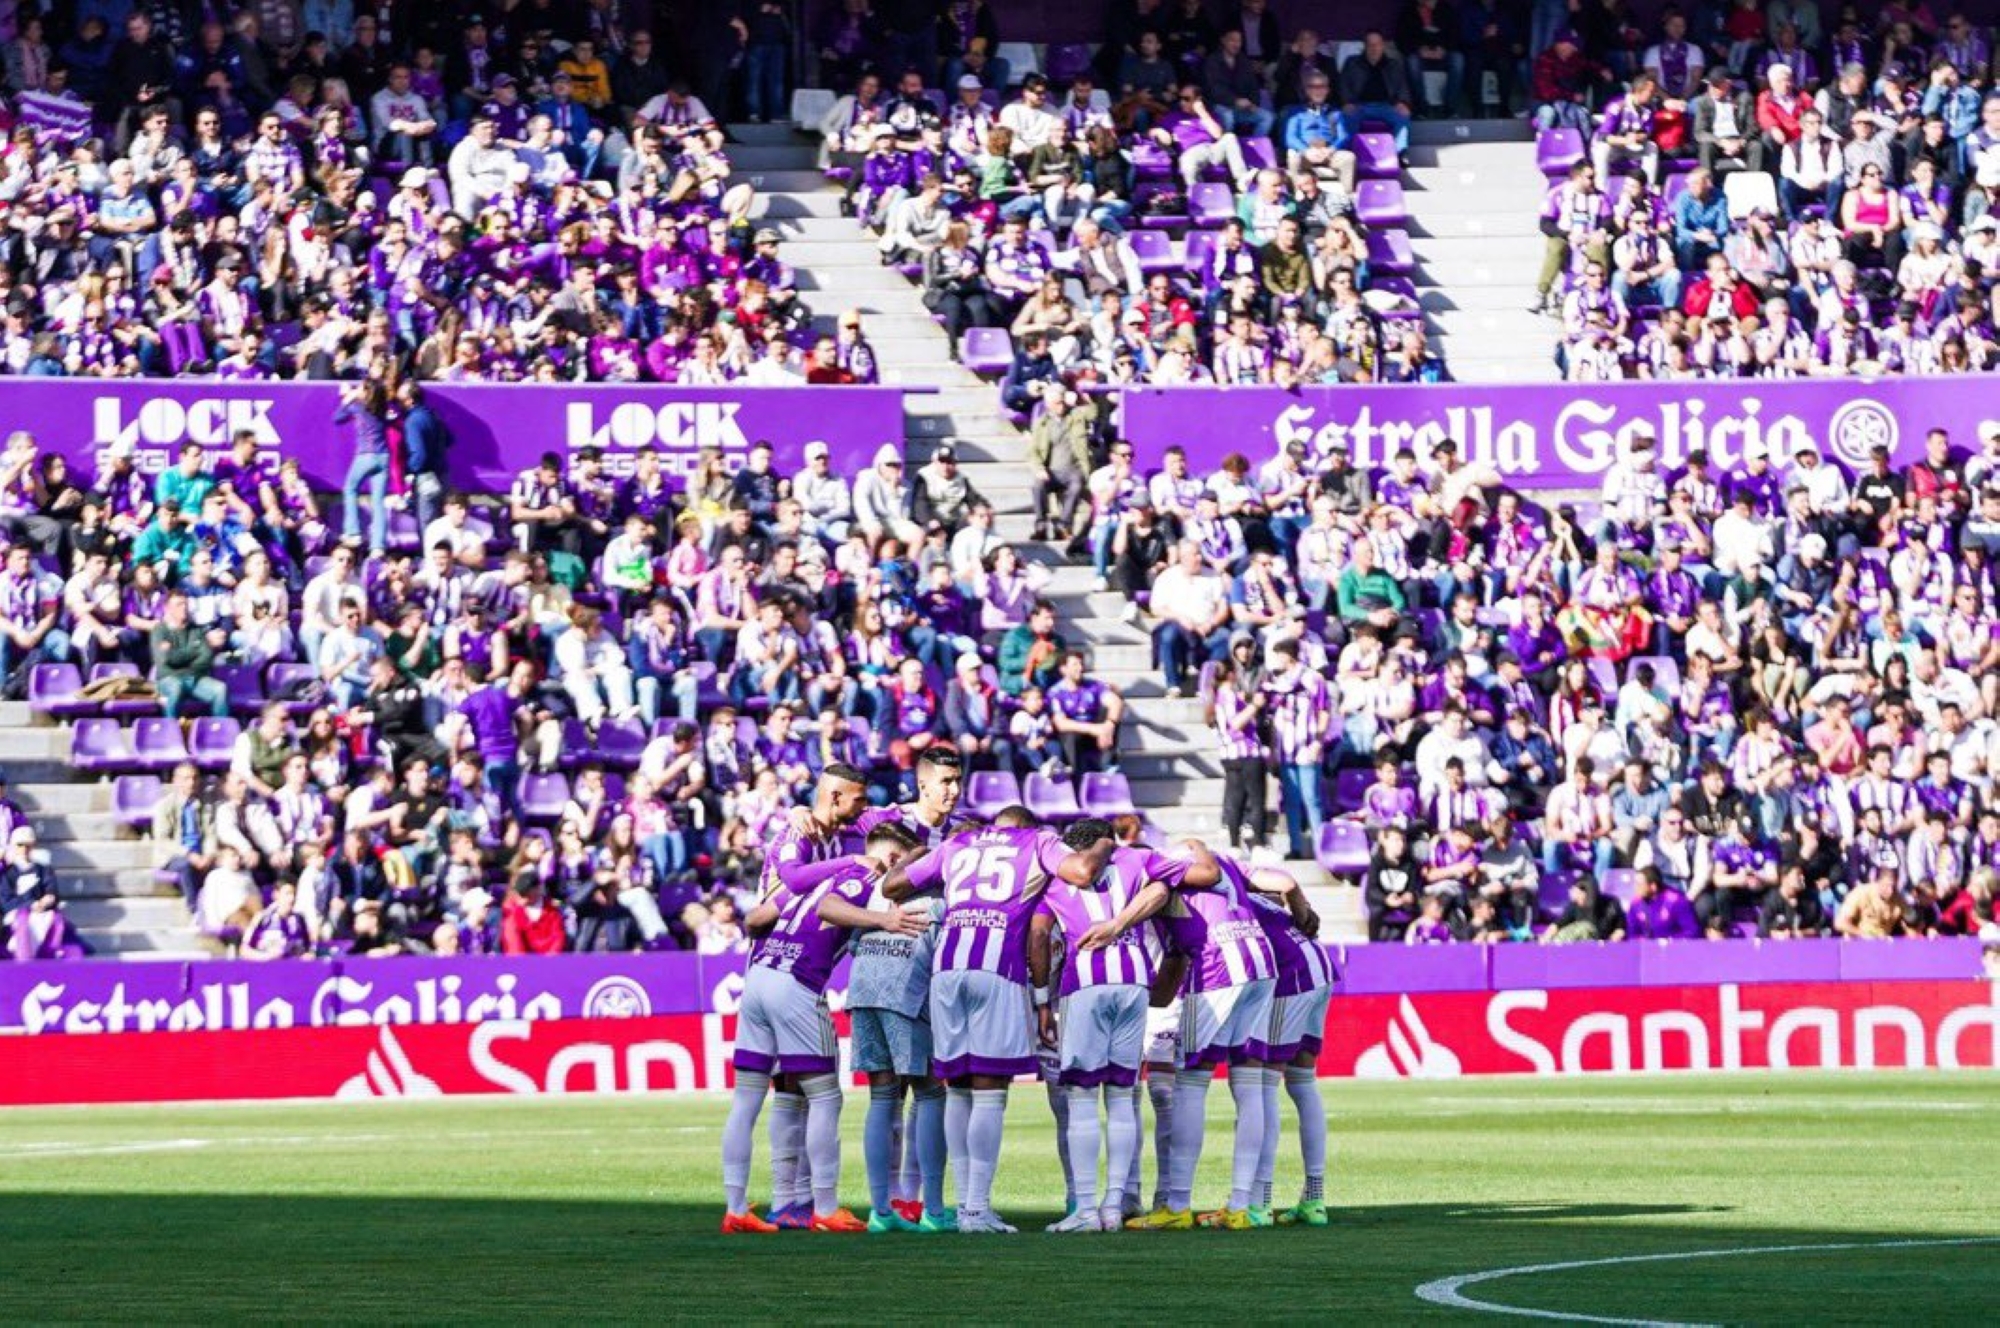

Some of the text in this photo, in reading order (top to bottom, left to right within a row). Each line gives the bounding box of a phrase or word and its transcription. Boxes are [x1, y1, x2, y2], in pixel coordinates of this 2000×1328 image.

[94, 397, 281, 445] LOCK
[567, 402, 748, 447] LOCK
[1274, 397, 1814, 474] Estrella Galicia
[948, 846, 1019, 908] 25
